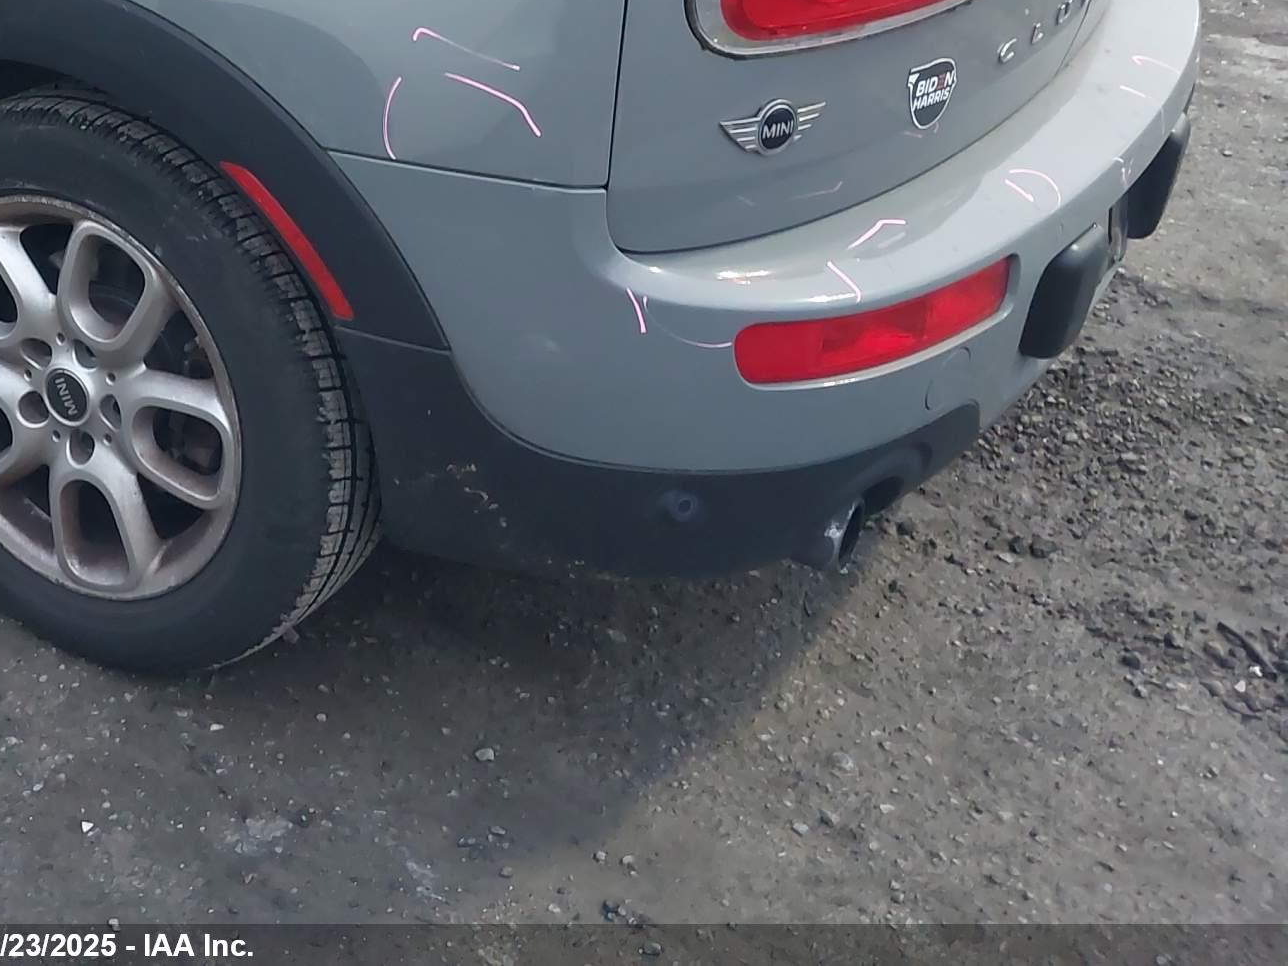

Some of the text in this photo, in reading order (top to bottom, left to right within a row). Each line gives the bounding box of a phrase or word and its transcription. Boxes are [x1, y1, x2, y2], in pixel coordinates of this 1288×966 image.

[915, 70, 955, 97] BIDEN
[912, 87, 951, 112] HARRIS
[762, 120, 794, 139] MINI
[54, 377, 79, 415] MINI
